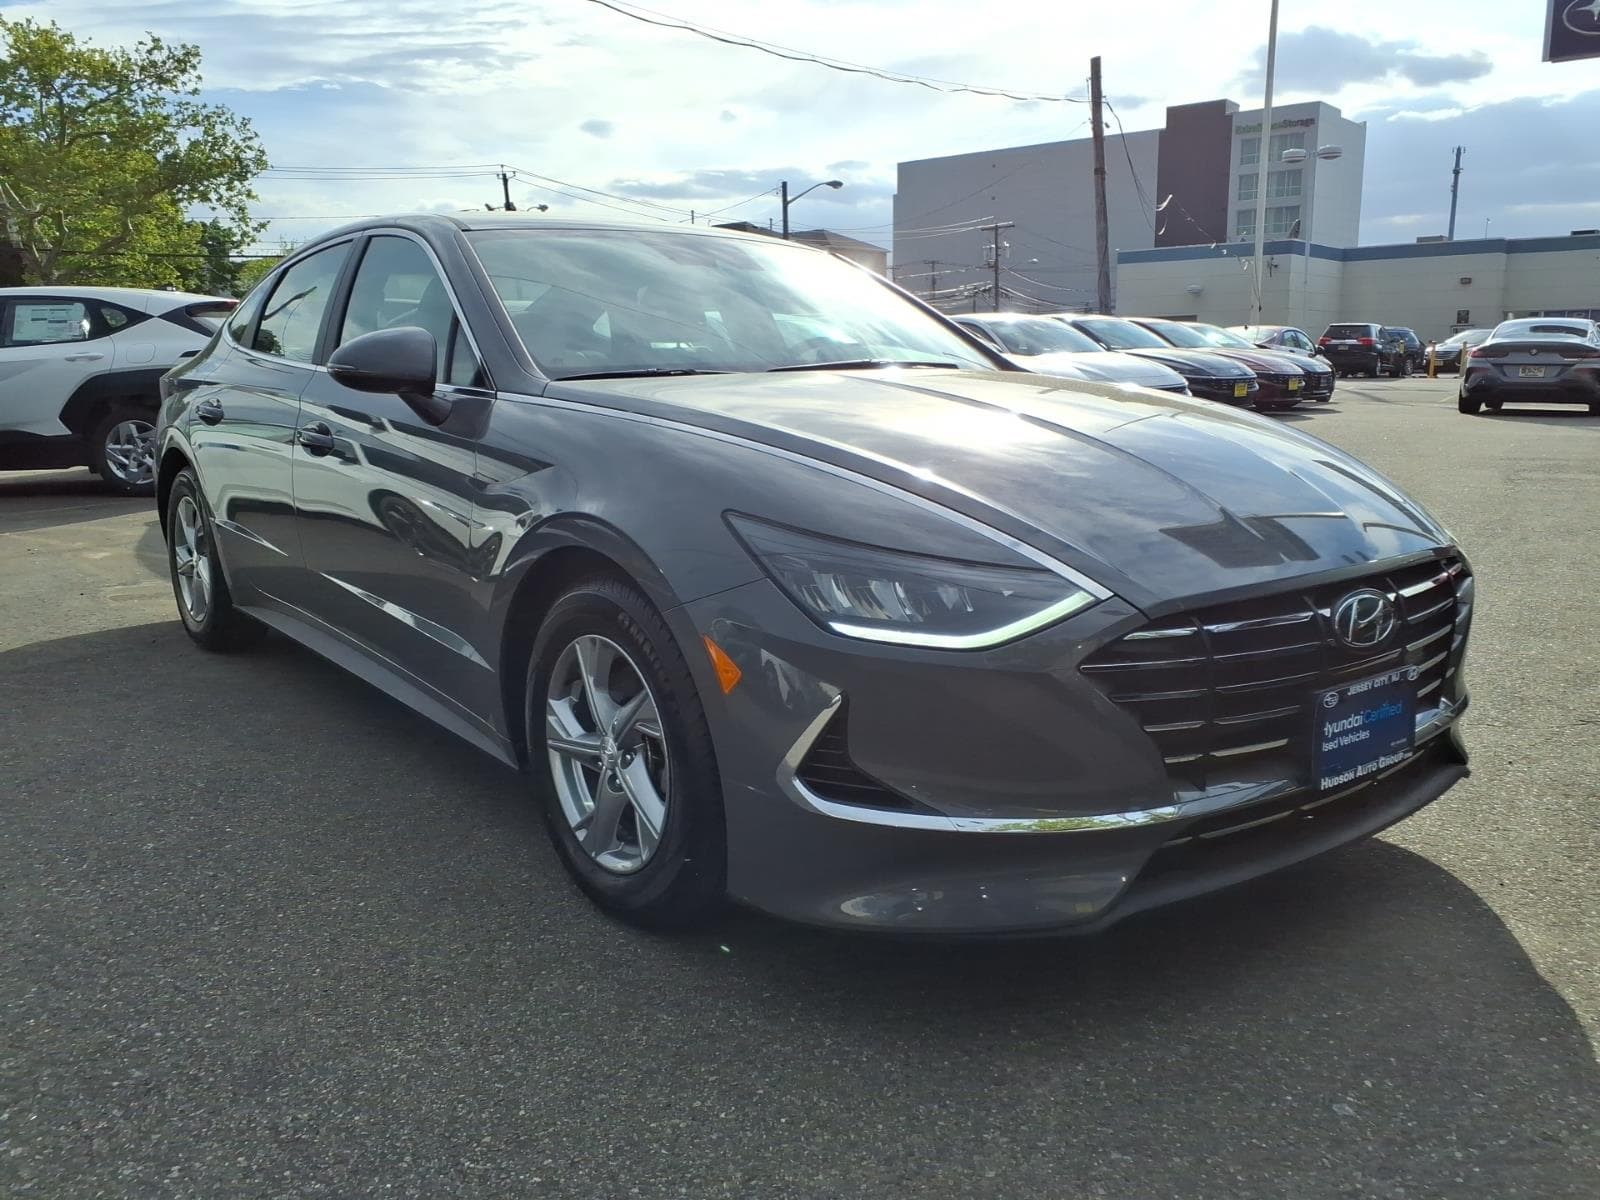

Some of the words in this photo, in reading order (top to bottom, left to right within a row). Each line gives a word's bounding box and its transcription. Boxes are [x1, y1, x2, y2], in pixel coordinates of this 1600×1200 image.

[1347, 680, 1373, 695] JERSEY
[1339, 730, 1370, 746] Vehicles
[1320, 770, 1355, 790] HUDSON
[1356, 762, 1377, 777] AUTO
